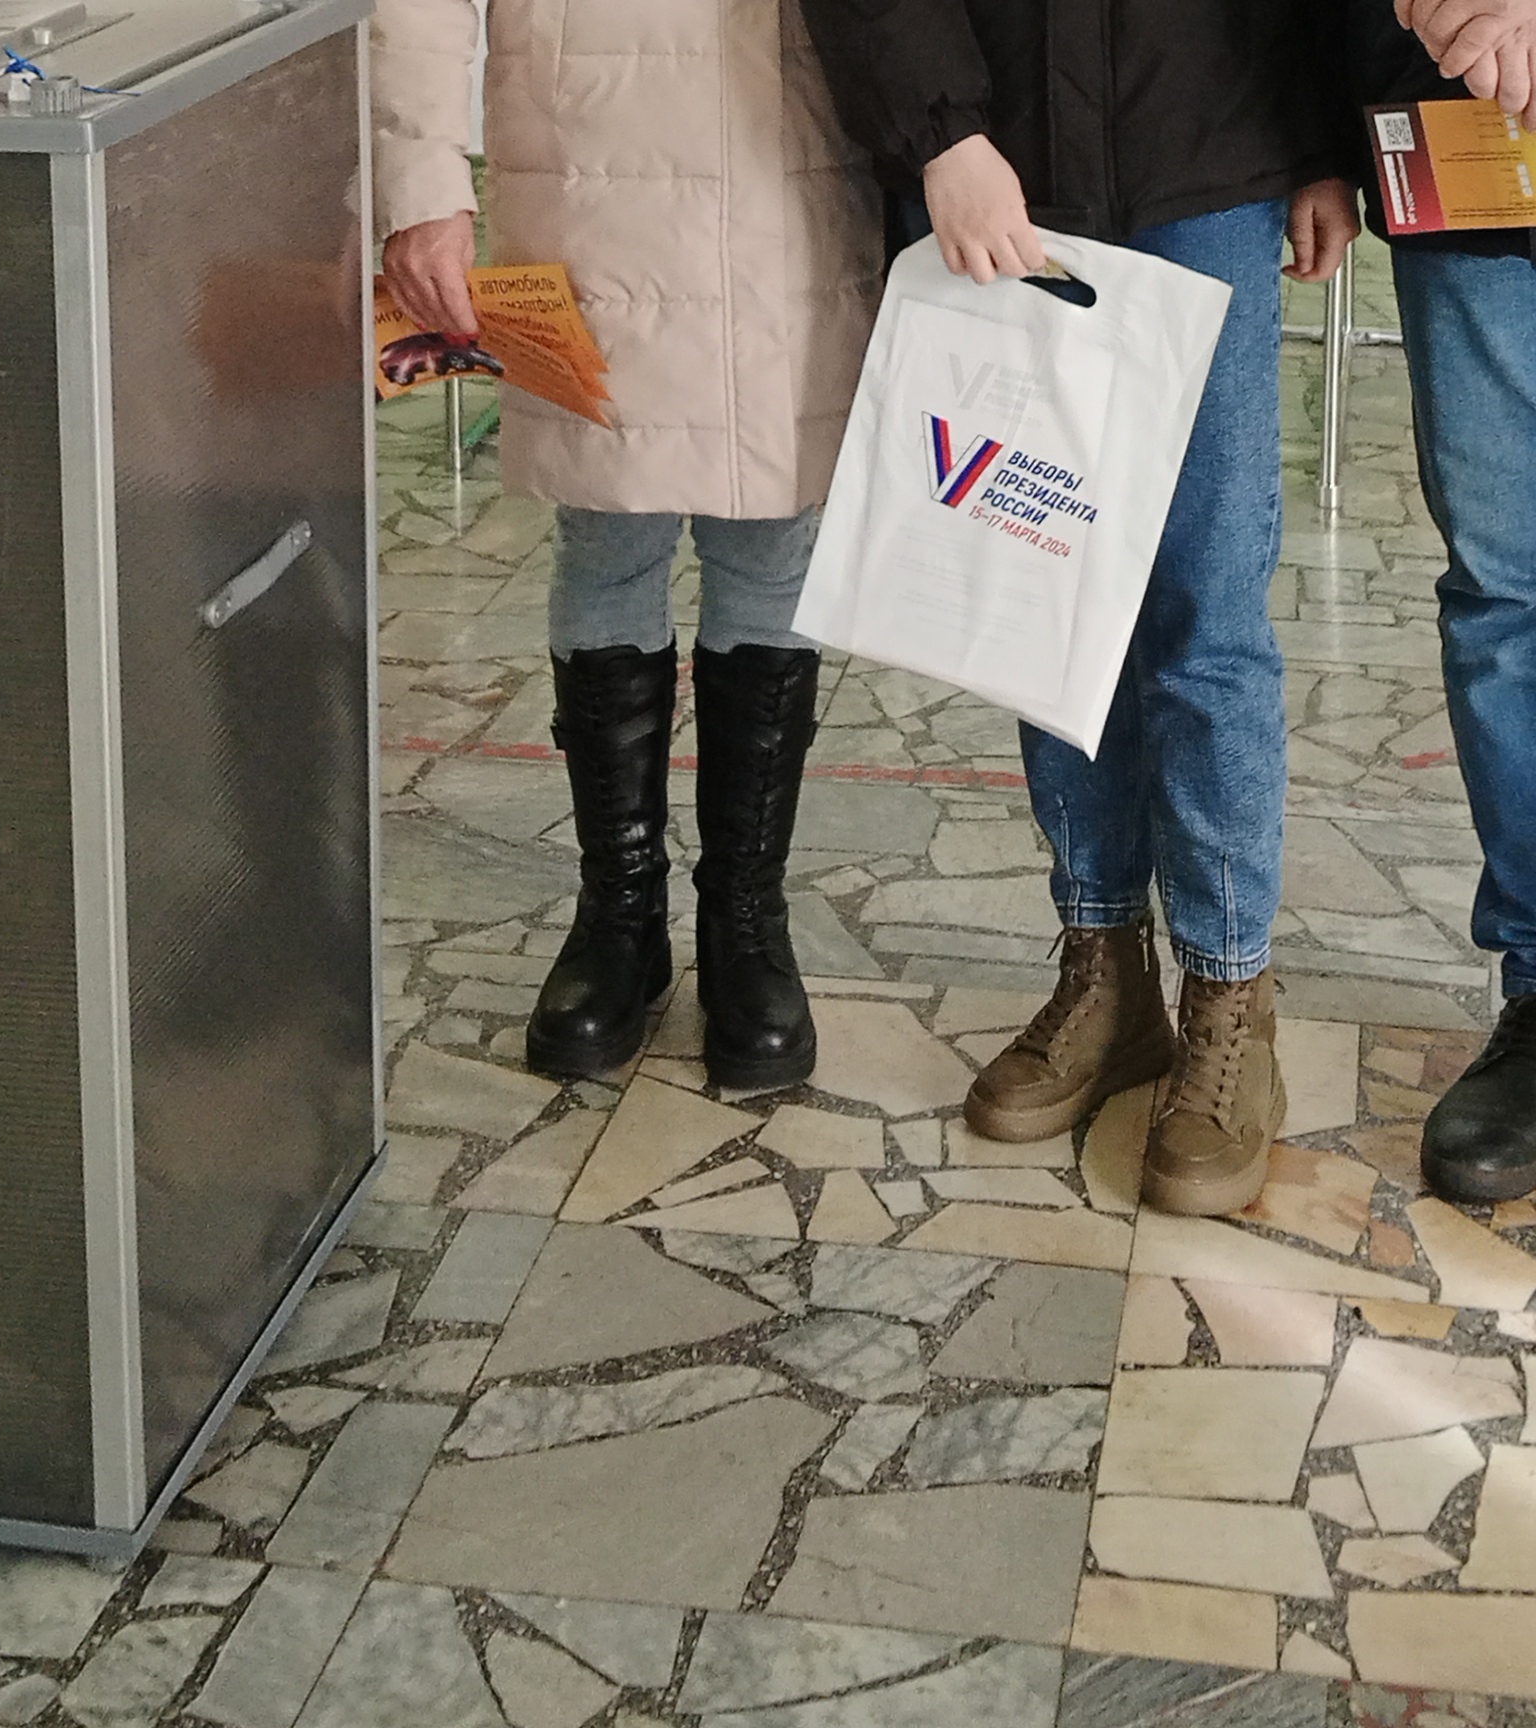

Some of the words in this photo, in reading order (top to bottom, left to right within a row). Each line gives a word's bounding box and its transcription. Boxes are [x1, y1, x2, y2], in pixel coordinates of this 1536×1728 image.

[478, 274, 558, 295] автомобиль
[1007, 450, 1084, 492] ВЫБОРЫ
[979, 488, 1049, 526] РОССИИ
[993, 469, 1099, 525] ПРЕЗИДЕНТА
[999, 519, 1043, 546] МАРТА
[1039, 536, 1072, 558] 2024
